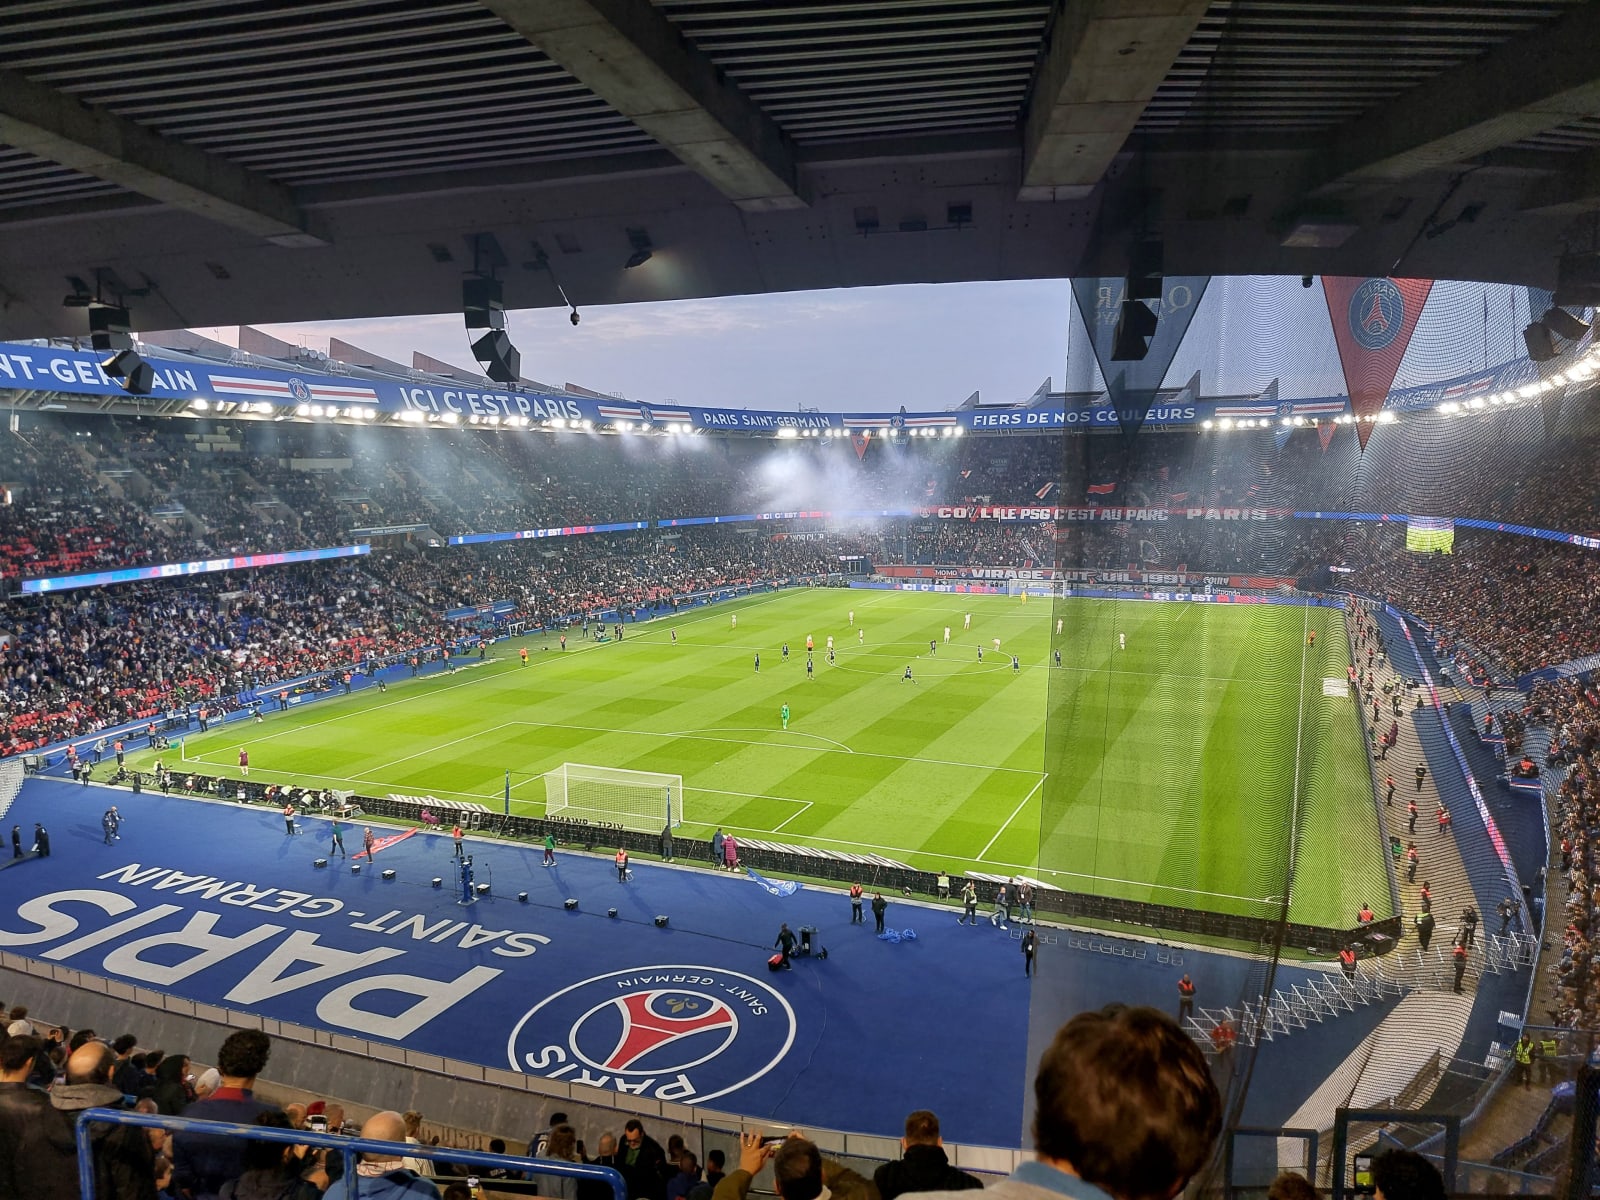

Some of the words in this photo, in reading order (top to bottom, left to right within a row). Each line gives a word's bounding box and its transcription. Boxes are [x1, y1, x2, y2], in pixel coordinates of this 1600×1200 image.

[0, 353, 198, 392] NT-GEAIN
[400, 387, 439, 412] ICI
[443, 391, 513, 416] C'EST
[515, 396, 582, 420] PARIS
[703, 412, 738, 425] PARIS
[741, 414, 830, 428] SAINT-GERMAIN
[973, 415, 1021, 426] FIERS
[1026, 413, 1049, 424] DE
[1053, 412, 1091, 423] NOS
[1096, 408, 1195, 422] COULEURS
[1000, 508, 1016, 520] LE
[1020, 508, 1050, 520] PSG
[1053, 508, 1096, 521] C'EST
[1101, 508, 1121, 521] AU
[1125, 508, 1168, 521] PARC
[1186, 508, 1267, 521] PARIS
[971, 569, 1044, 580] VIRAGE
[1050, 571, 1134, 583] AUTUIL
[97, 863, 551, 957] SAINT-GERMAIN
[0, 889, 503, 1040] PARIS
[617, 974, 714, 989] GERMAIN
[725, 985, 768, 1016] SAINT
[525, 1045, 696, 1100] PARIS
